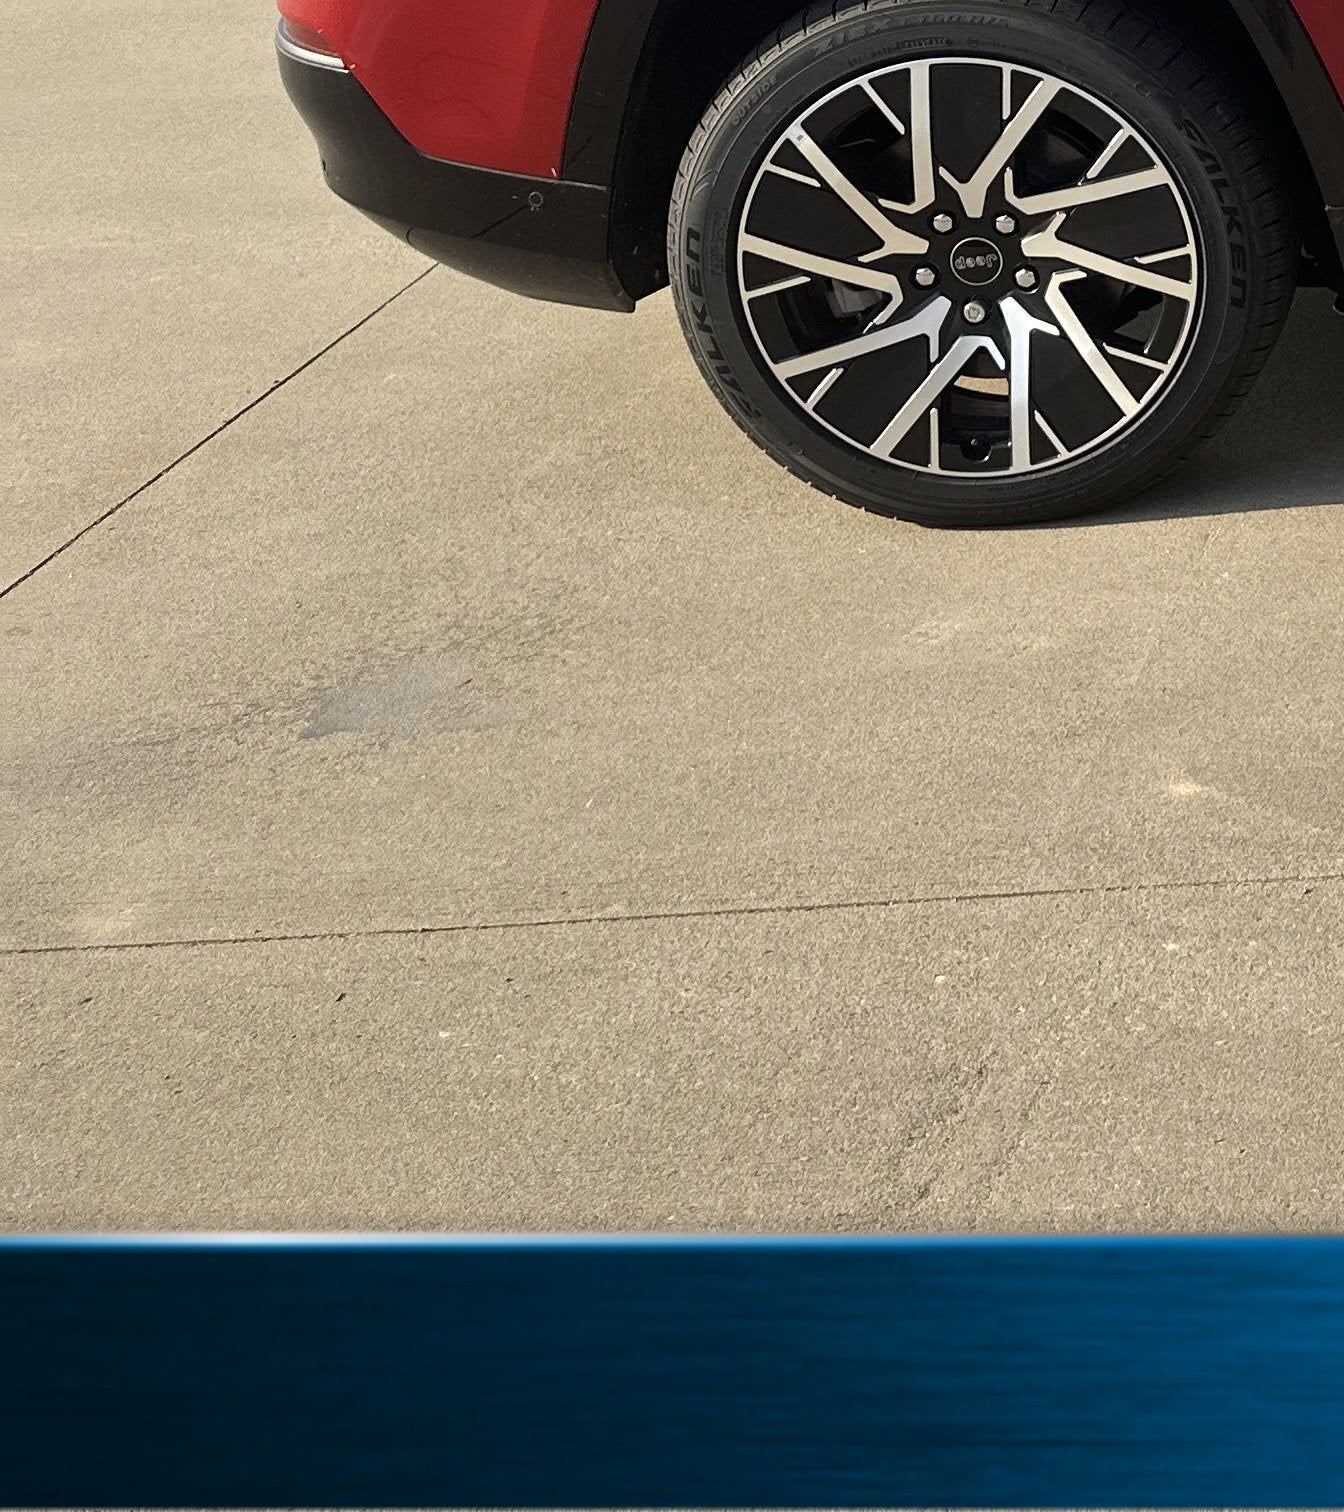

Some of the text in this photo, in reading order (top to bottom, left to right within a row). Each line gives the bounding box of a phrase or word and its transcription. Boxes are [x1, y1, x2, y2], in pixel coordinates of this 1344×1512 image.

[954, 252, 998, 271] Jeep
[1174, 116, 1249, 309] FALKEN
[685, 226, 763, 422] FALKEN
